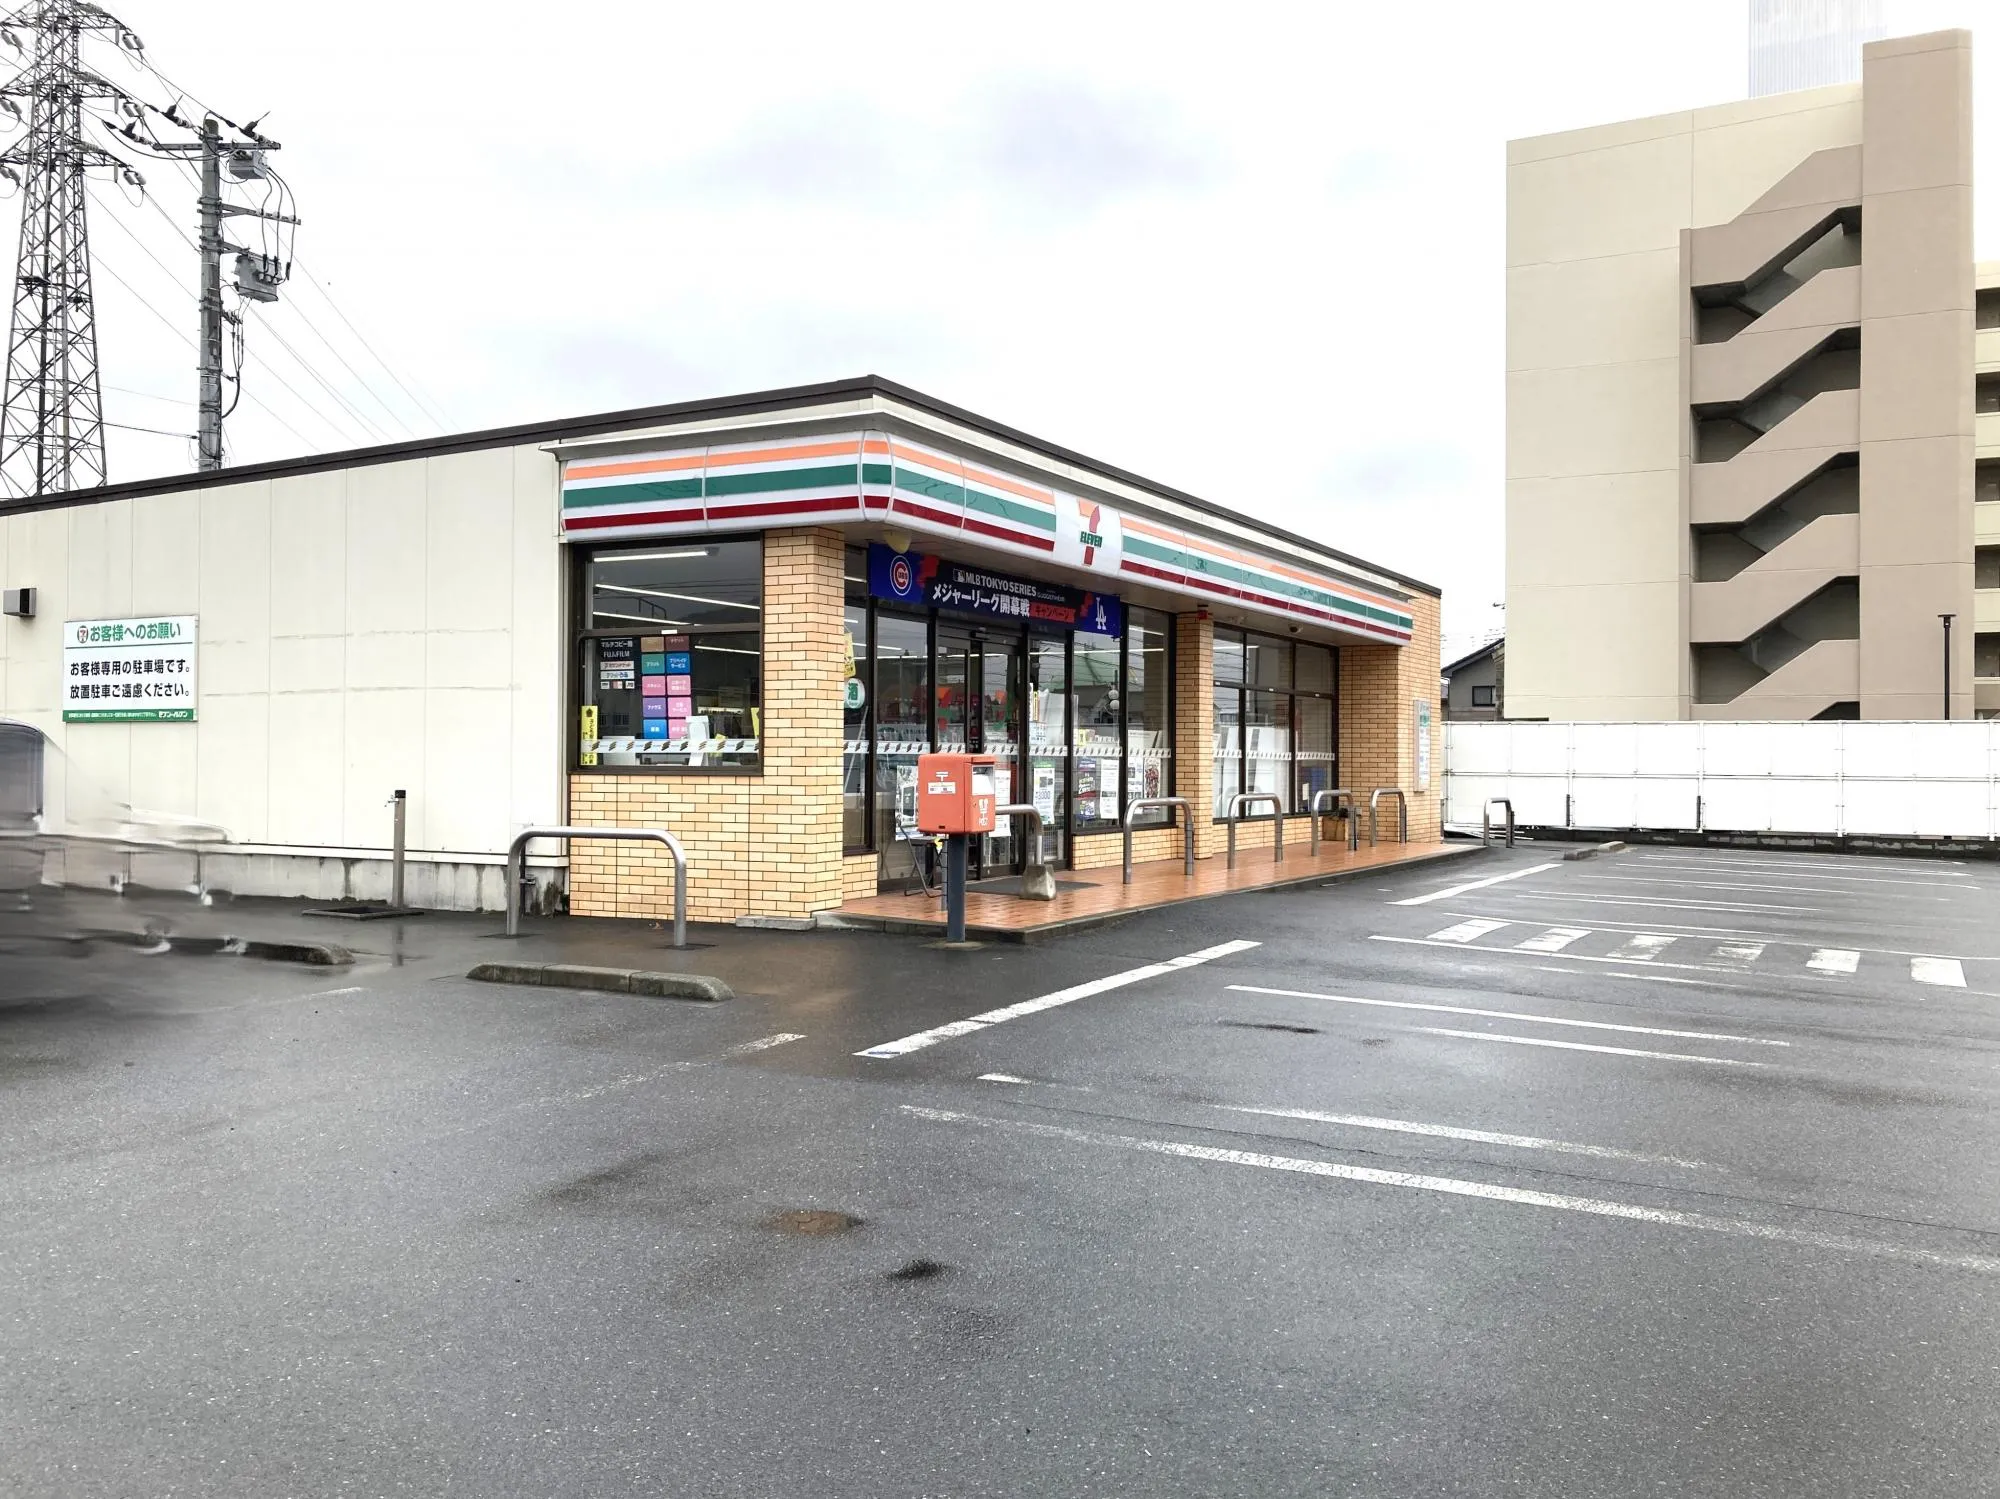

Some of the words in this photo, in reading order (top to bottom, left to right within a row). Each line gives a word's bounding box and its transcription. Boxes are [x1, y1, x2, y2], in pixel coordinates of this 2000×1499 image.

[965, 571, 980, 586] MLB
[981, 575, 1009, 591] TOKYO
[1008, 581, 1037, 597] SERIES
[932, 583, 1030, 618] メジャーリーグ開幕戦
[90, 622, 181, 642] お客様へのお願い
[70, 659, 189, 676] お客様専用の駐車場です。
[70, 683, 189, 699] 放置駐車ご遠慮ください。
